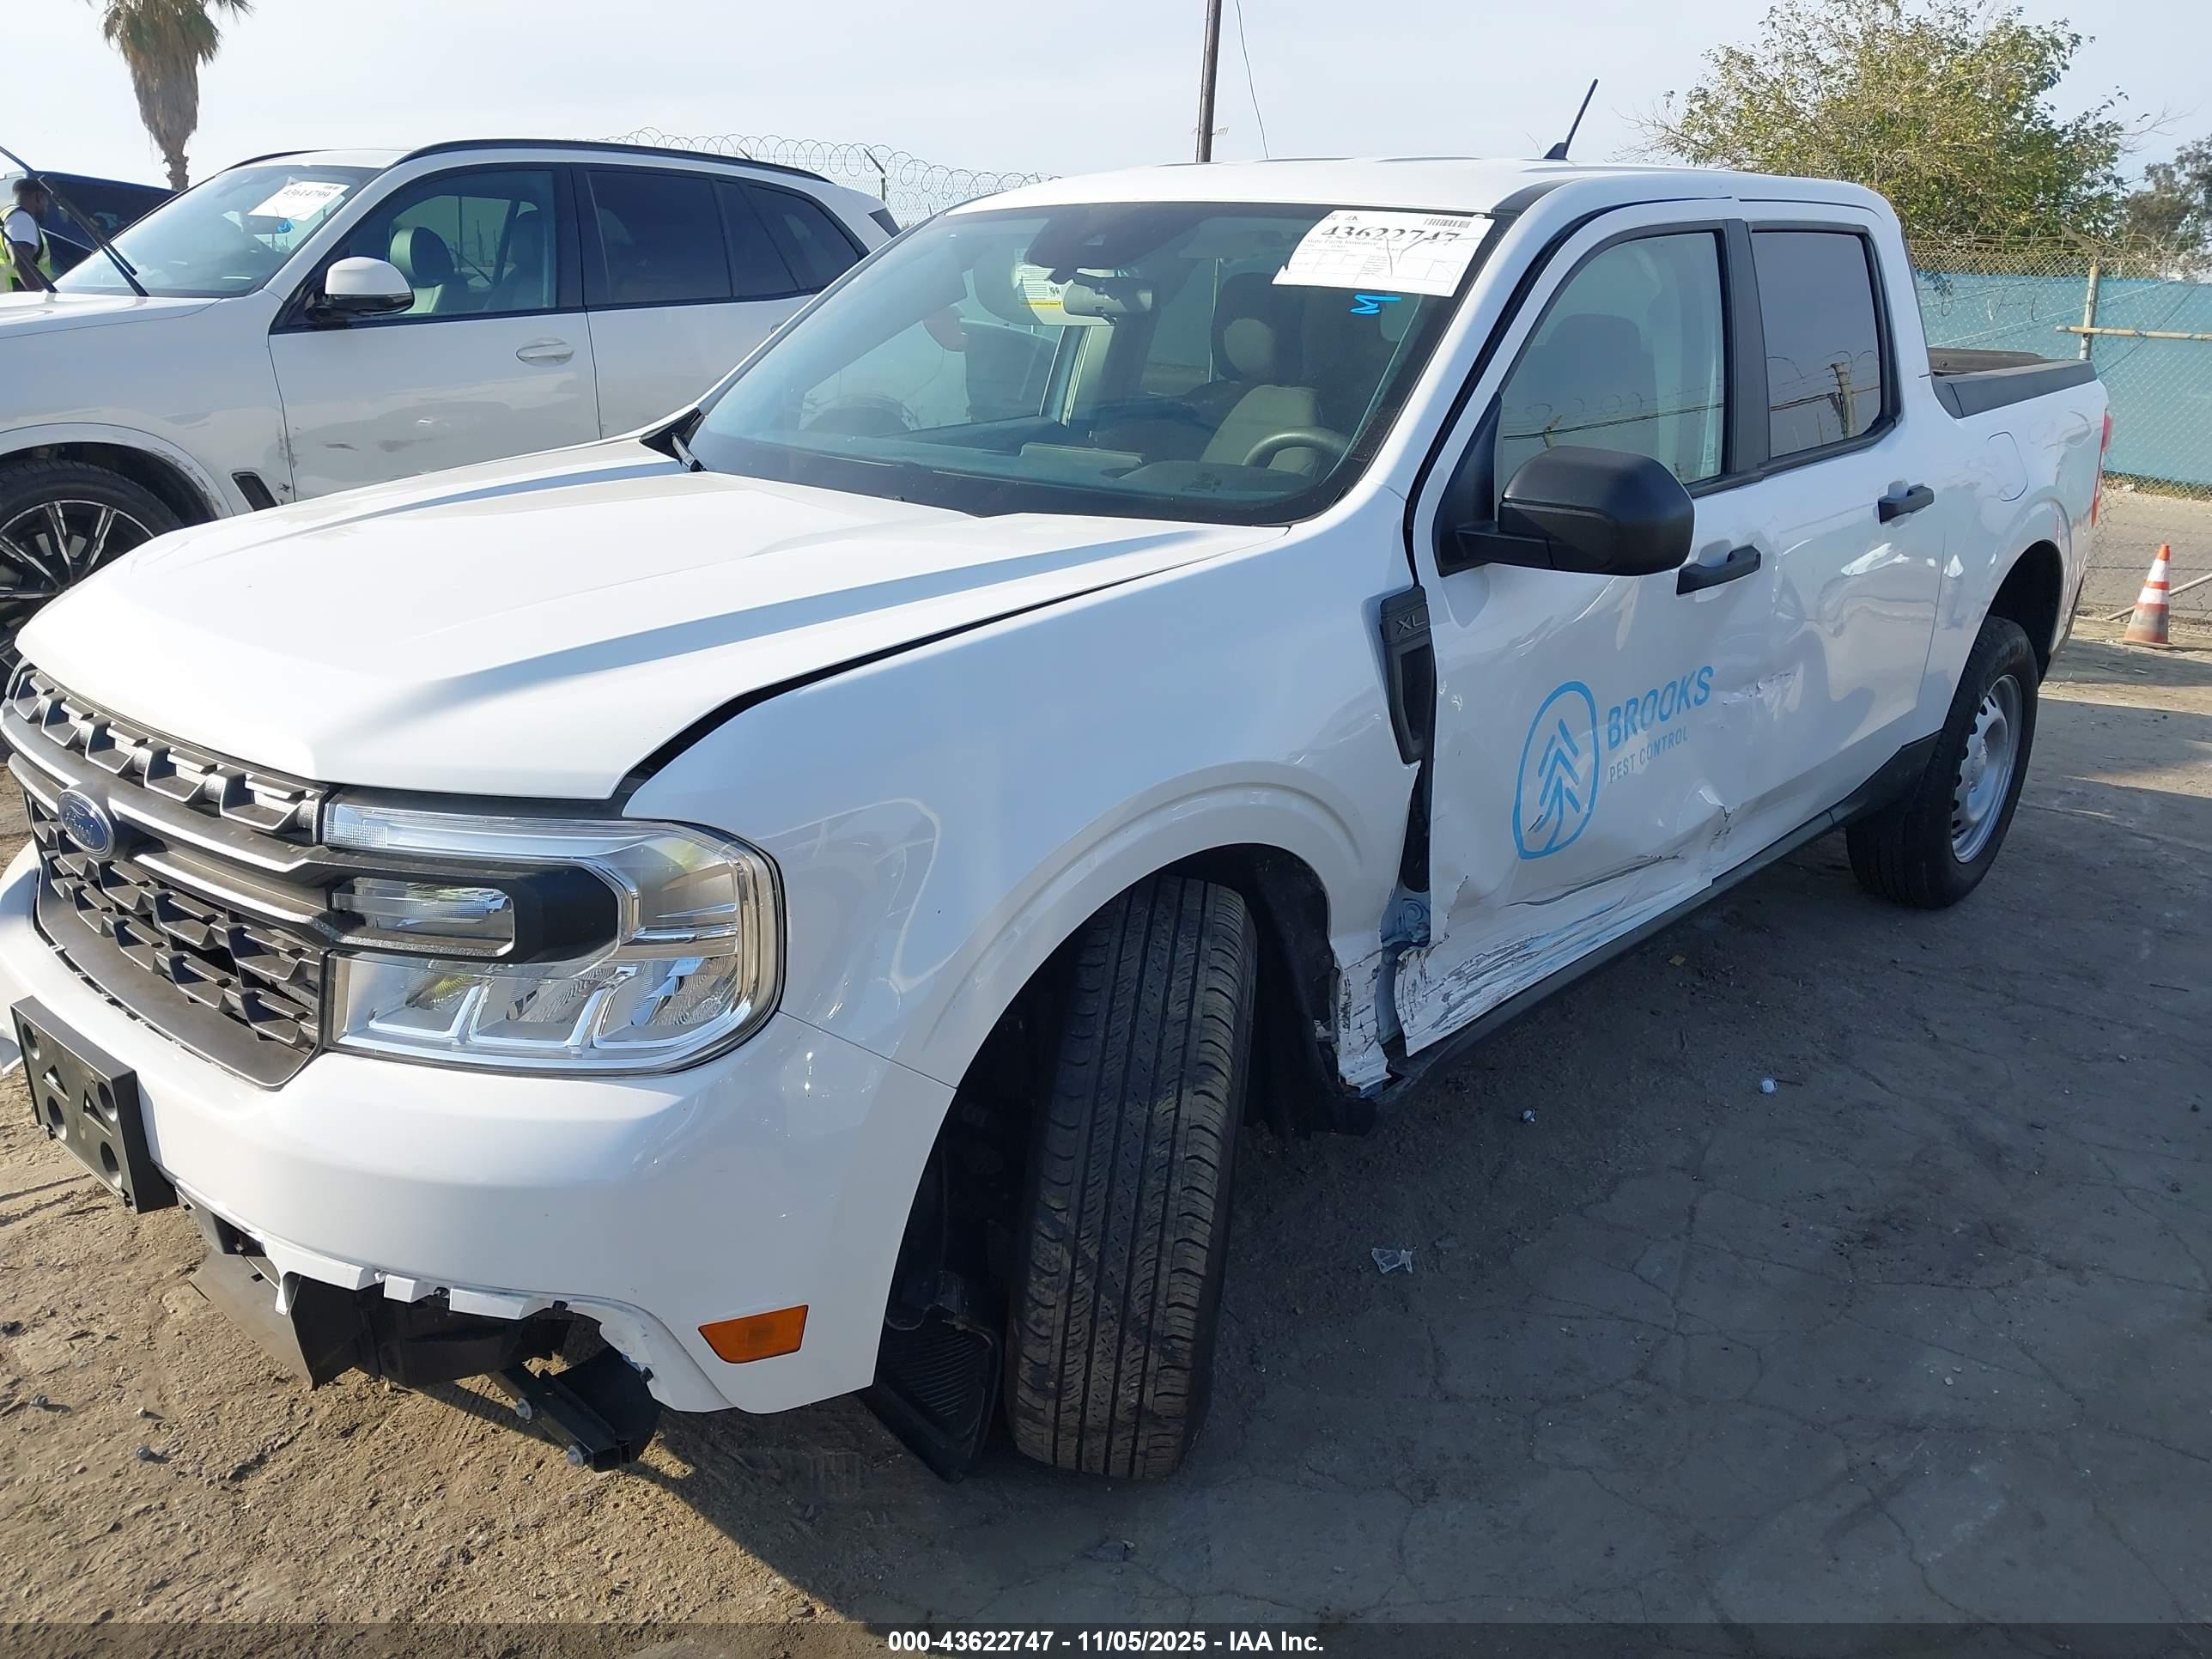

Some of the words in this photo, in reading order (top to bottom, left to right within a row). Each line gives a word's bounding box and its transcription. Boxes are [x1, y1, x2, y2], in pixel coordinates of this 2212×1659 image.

[1321, 226, 1462, 246] 43622747
[1398, 615, 1425, 634] XL
[1608, 666, 1713, 750] BROOKS
[1610, 755, 1635, 783] PEST
[1639, 726, 1688, 764] CONTROL
